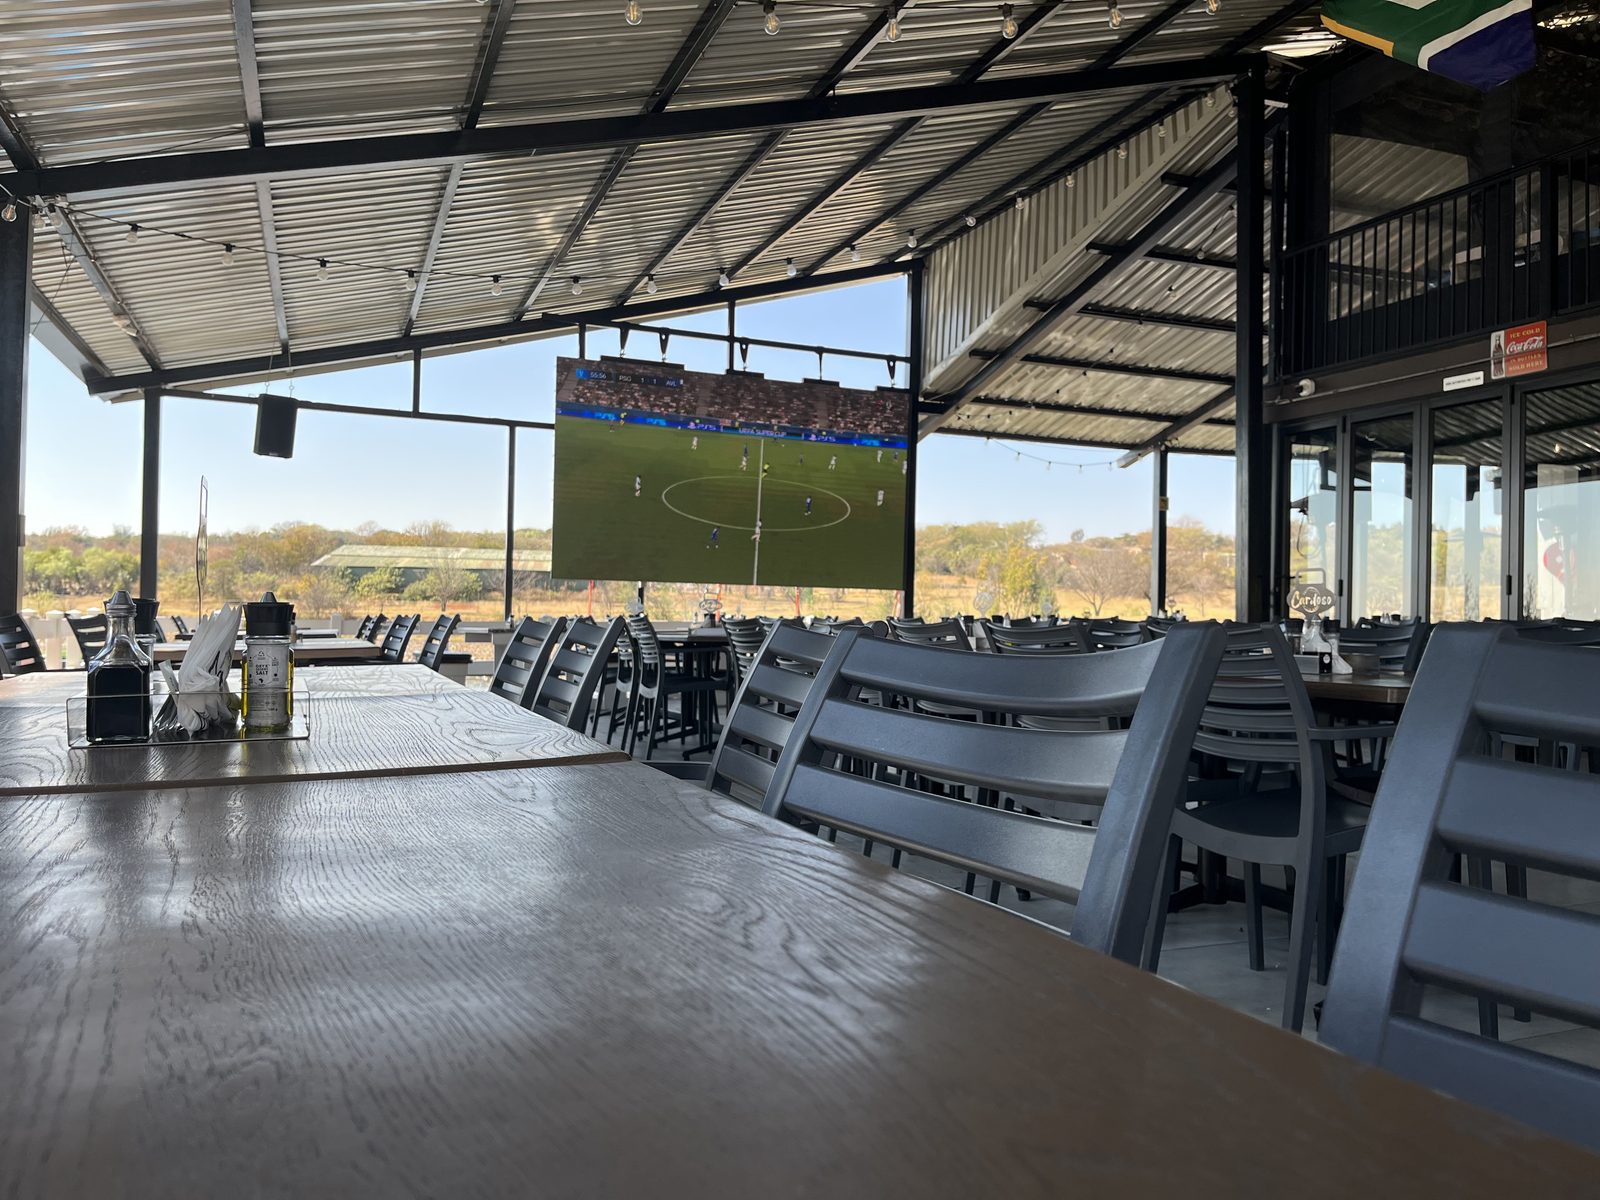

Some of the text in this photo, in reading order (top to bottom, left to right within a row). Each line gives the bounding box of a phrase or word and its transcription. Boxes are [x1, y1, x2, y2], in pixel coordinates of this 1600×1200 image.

[1522, 328, 1541, 336] COLD
[618, 374, 632, 382] PSG
[1290, 590, 1332, 609] Cardoso
